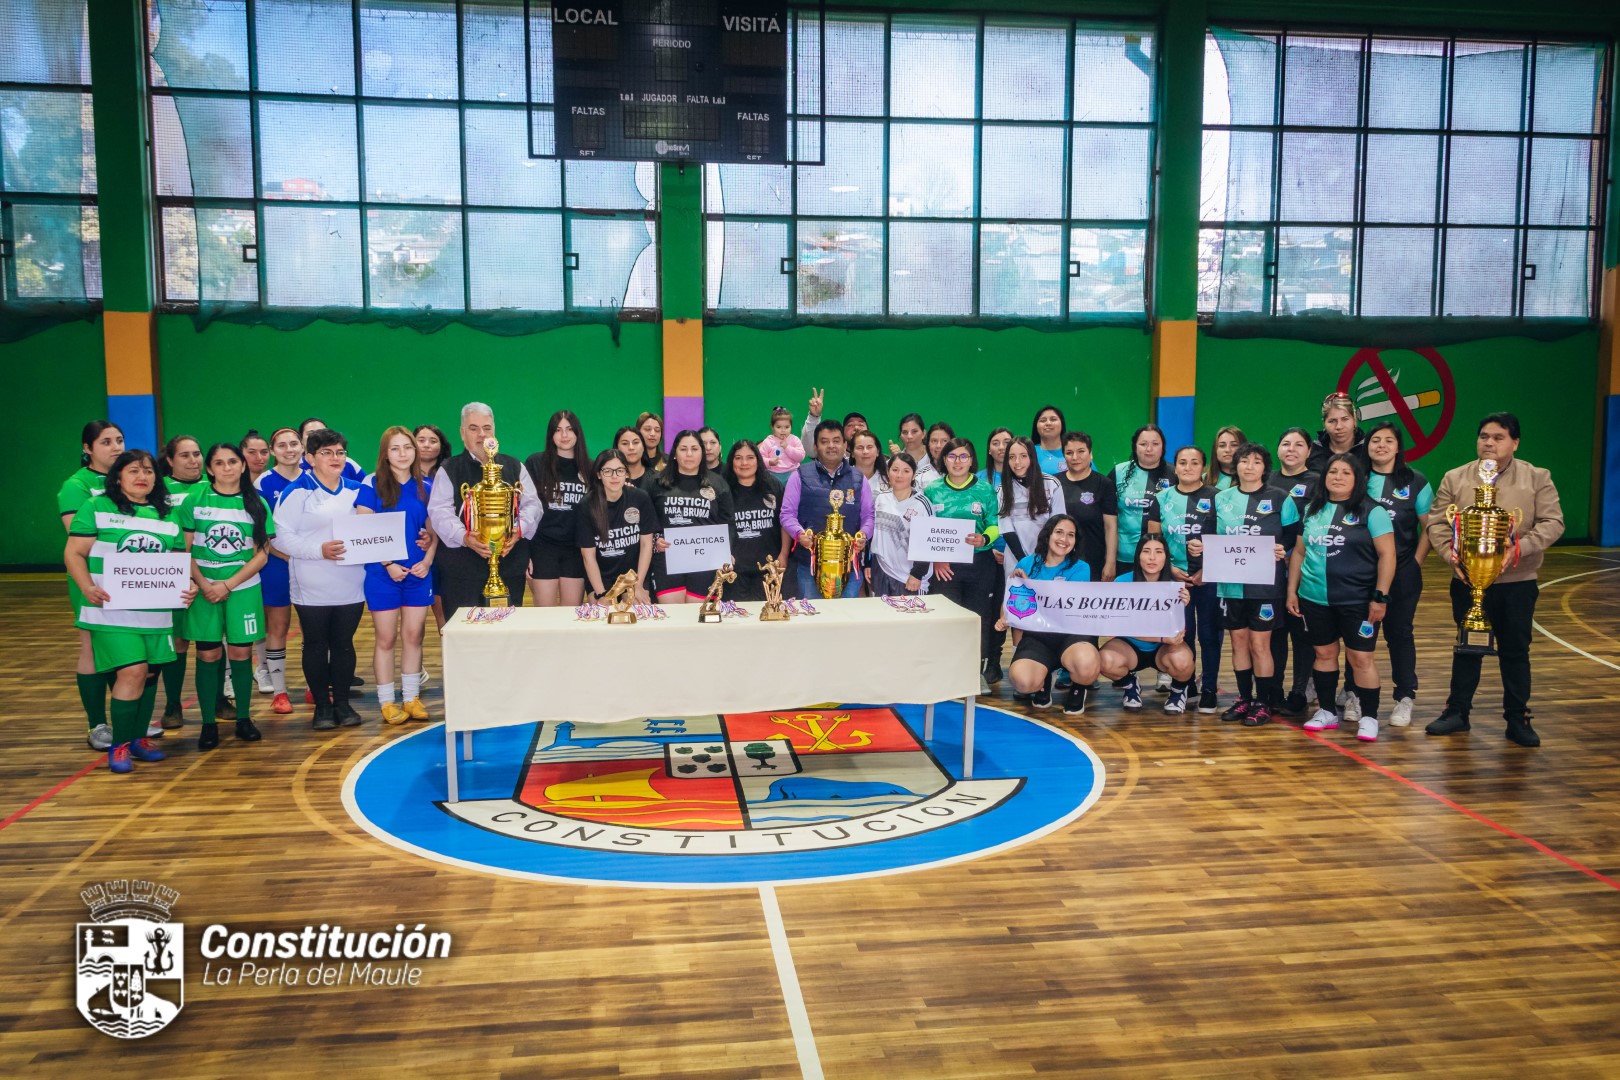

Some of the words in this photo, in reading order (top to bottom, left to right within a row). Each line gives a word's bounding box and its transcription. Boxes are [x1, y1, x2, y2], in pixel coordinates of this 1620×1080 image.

[553, 7, 619, 26] LOCAL
[652, 38, 692, 49] PERIODO
[641, 93, 678, 103] JUGADOR
[686, 95, 710, 105] FALTA
[571, 106, 606, 117] FALTAS
[737, 112, 770, 122] FALTAS
[664, 496, 711, 510] JUSTICIA
[664, 506, 682, 515] PARA
[683, 506, 710, 519] BRUMA
[734, 509, 774, 521] JUSTICIA
[930, 527, 958, 536] BARRIO
[350, 535, 394, 547] TRAVESIA
[673, 536, 725, 546] GALACTICAS
[926, 536, 961, 545] ACEVEDO
[694, 548, 705, 556] FC
[930, 545, 955, 553] NORTE
[1224, 546, 1242, 554] LAS
[1244, 546, 1256, 554] 7K
[1234, 558, 1246, 566] FC
[113, 565, 184, 576] REVOLUCIÓN
[121, 580, 176, 589] FEMENINA
[244, 618, 257, 635] 10
[490, 792, 988, 849] CONSTITUCION
